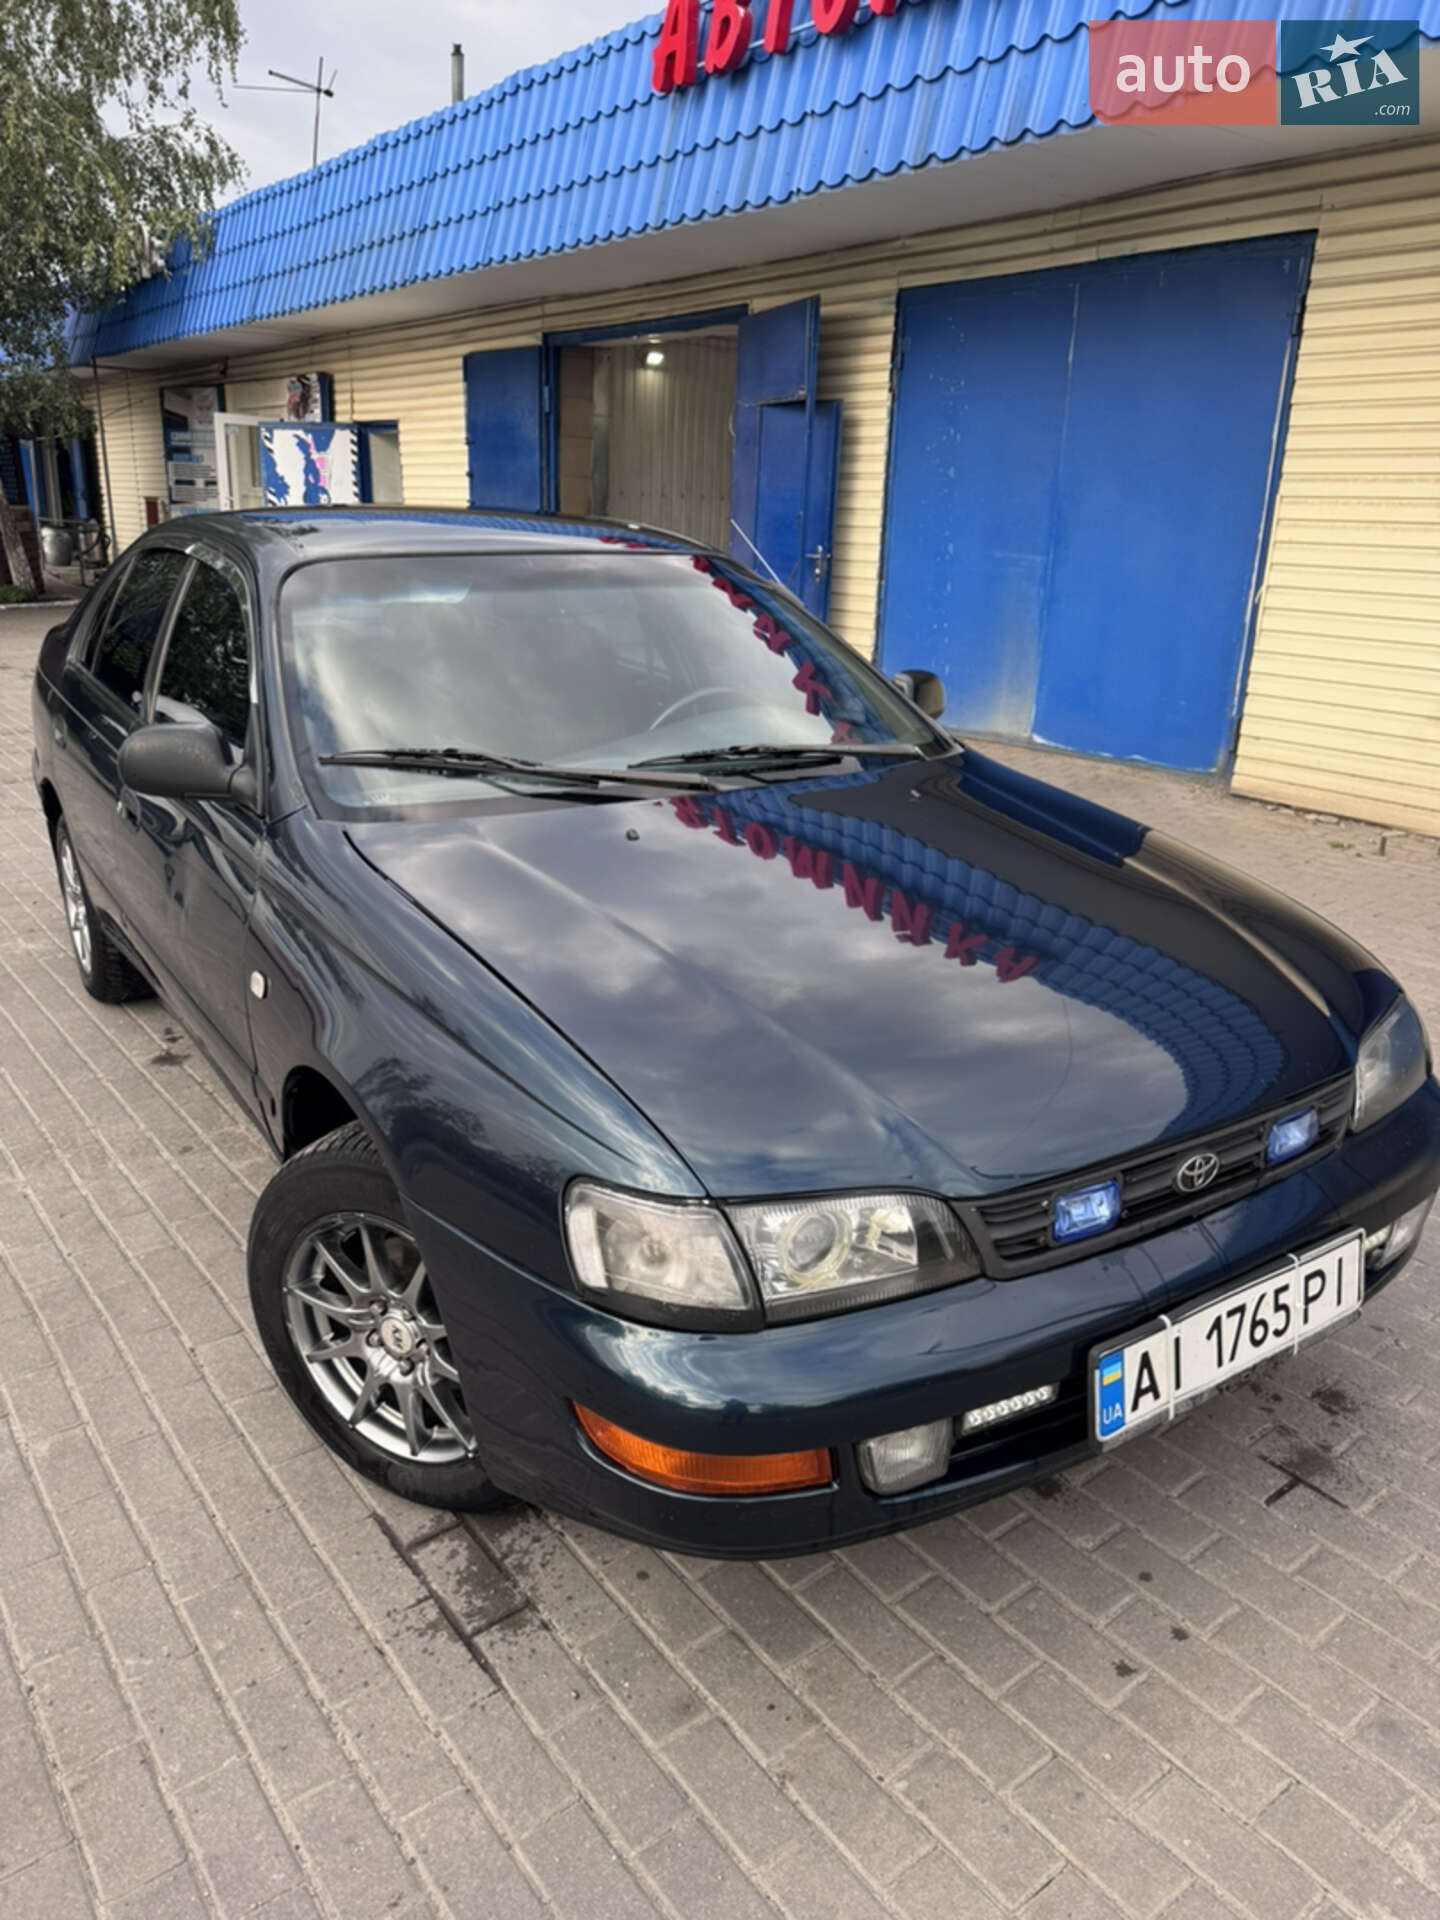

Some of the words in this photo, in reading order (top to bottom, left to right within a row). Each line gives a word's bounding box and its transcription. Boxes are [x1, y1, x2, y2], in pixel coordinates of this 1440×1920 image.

[1131, 1336, 1181, 1413] AI
[1206, 1284, 1290, 1369] 1765
[1303, 1257, 1343, 1325] PI
[1102, 1402, 1123, 1425] UA
